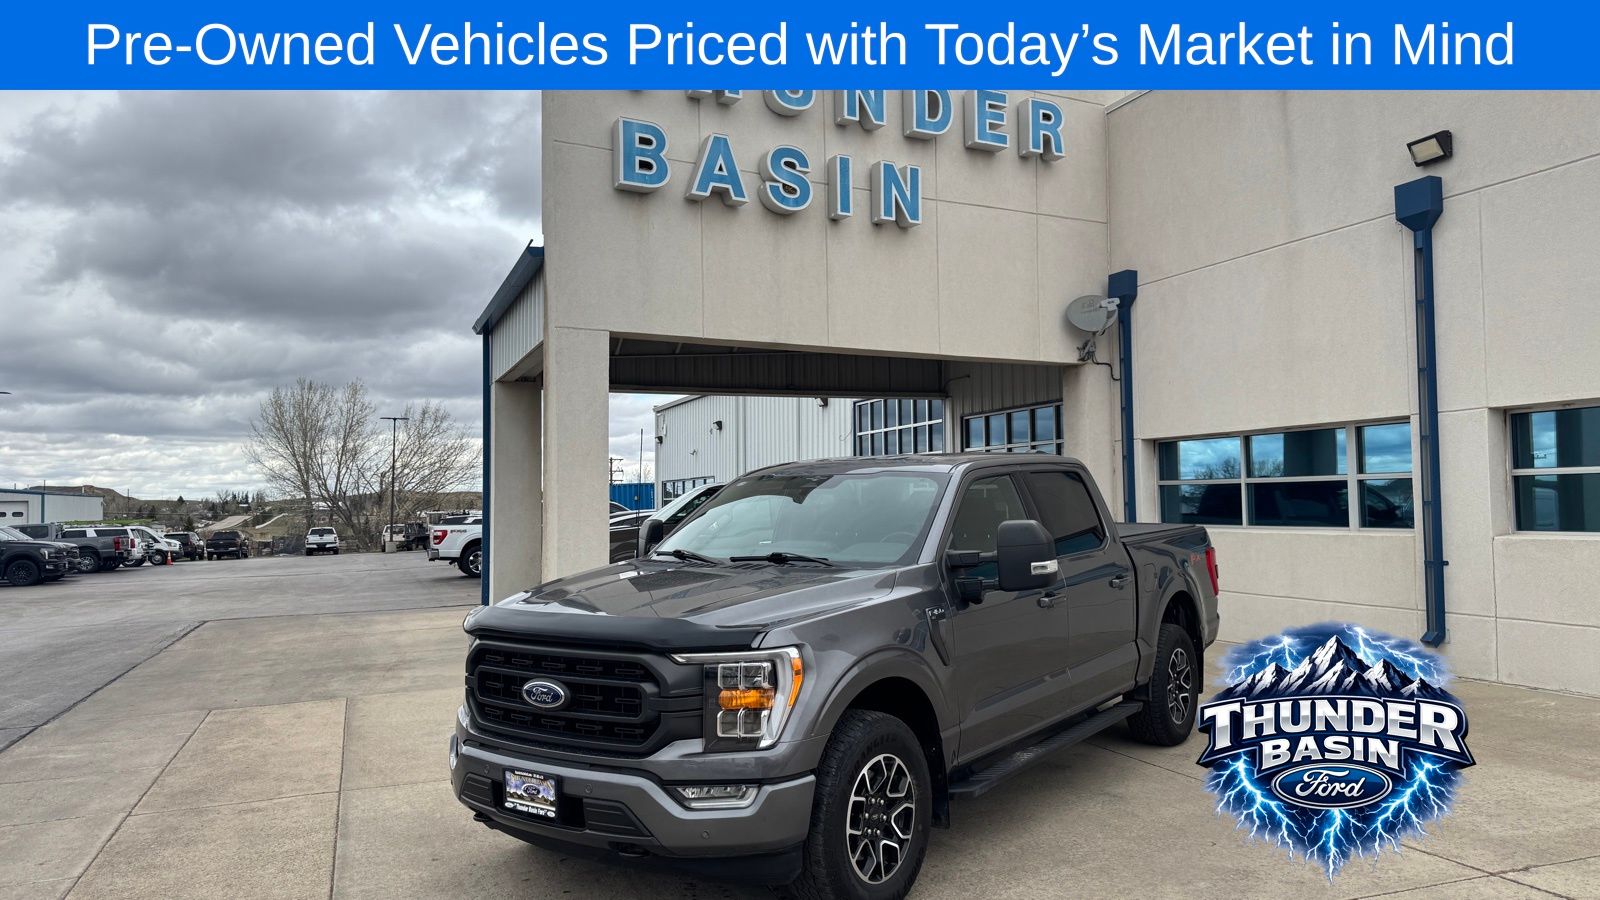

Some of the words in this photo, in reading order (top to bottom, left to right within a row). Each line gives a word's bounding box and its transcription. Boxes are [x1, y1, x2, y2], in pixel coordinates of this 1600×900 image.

[686, 90, 1066, 161] NDER
[613, 116, 922, 228] BASIN
[530, 686, 554, 703] Ford
